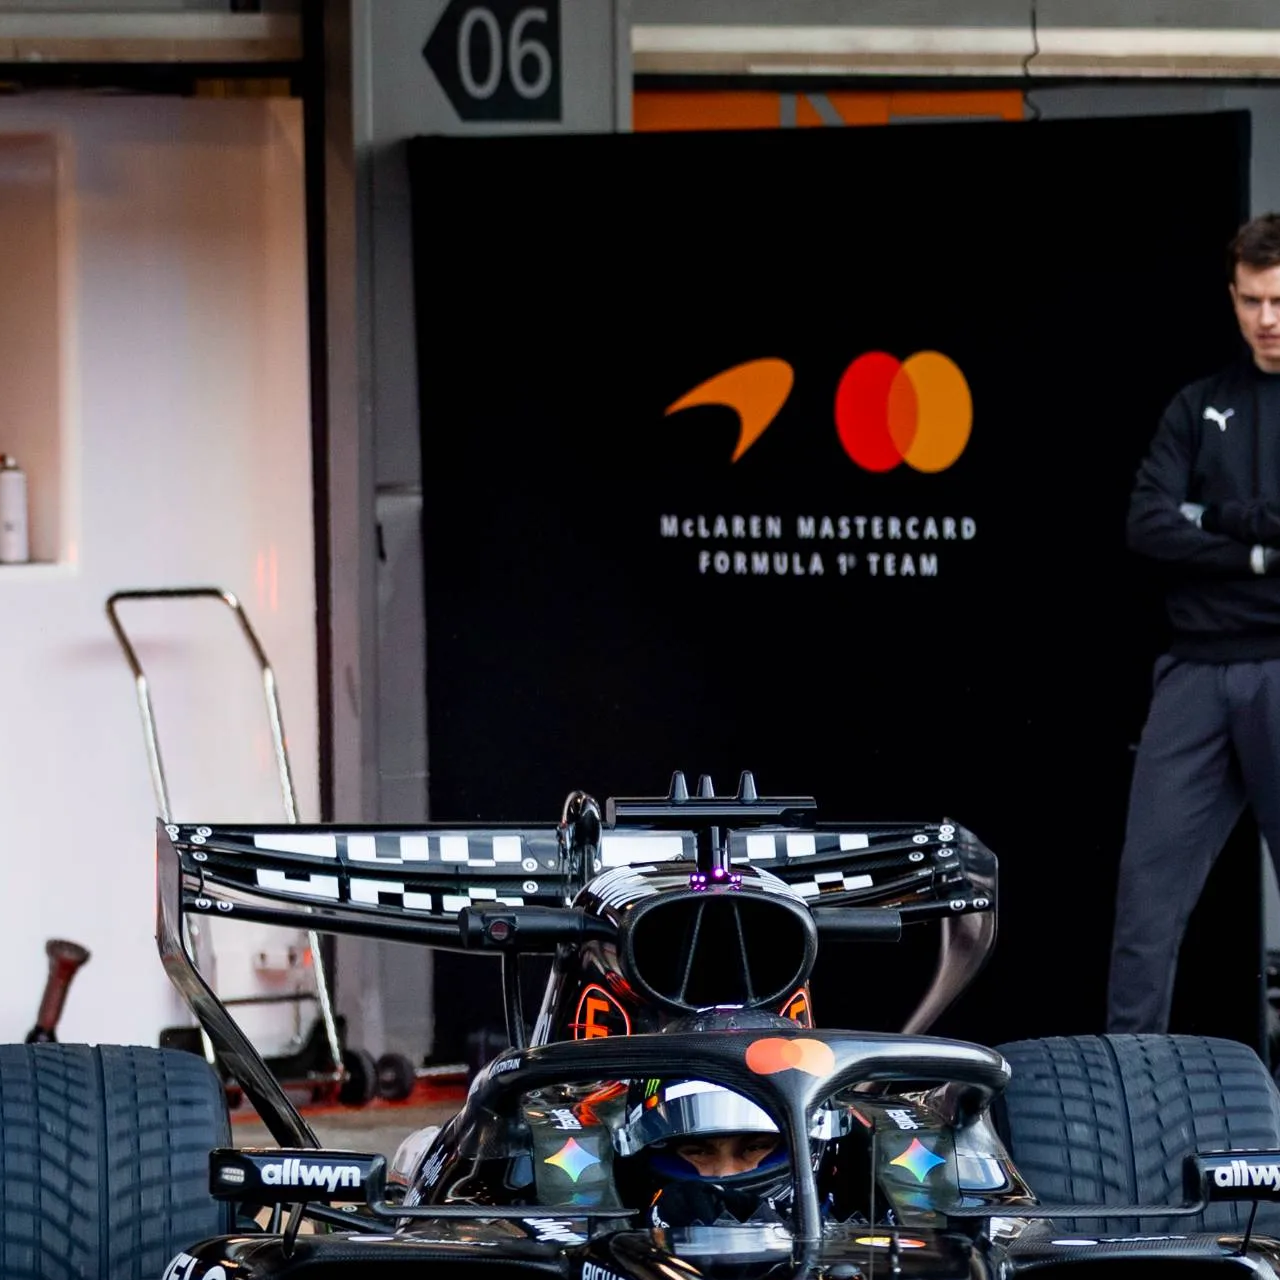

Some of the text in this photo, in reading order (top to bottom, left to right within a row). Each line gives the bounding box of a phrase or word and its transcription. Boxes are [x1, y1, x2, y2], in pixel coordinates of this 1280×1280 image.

[458, 6, 552, 100] 06
[660, 514, 976, 540] McLAREN MASTERCARD
[698, 550, 825, 575] FORMULA
[867, 552, 938, 577] TEAM
[261, 1158, 361, 1192] allwyn
